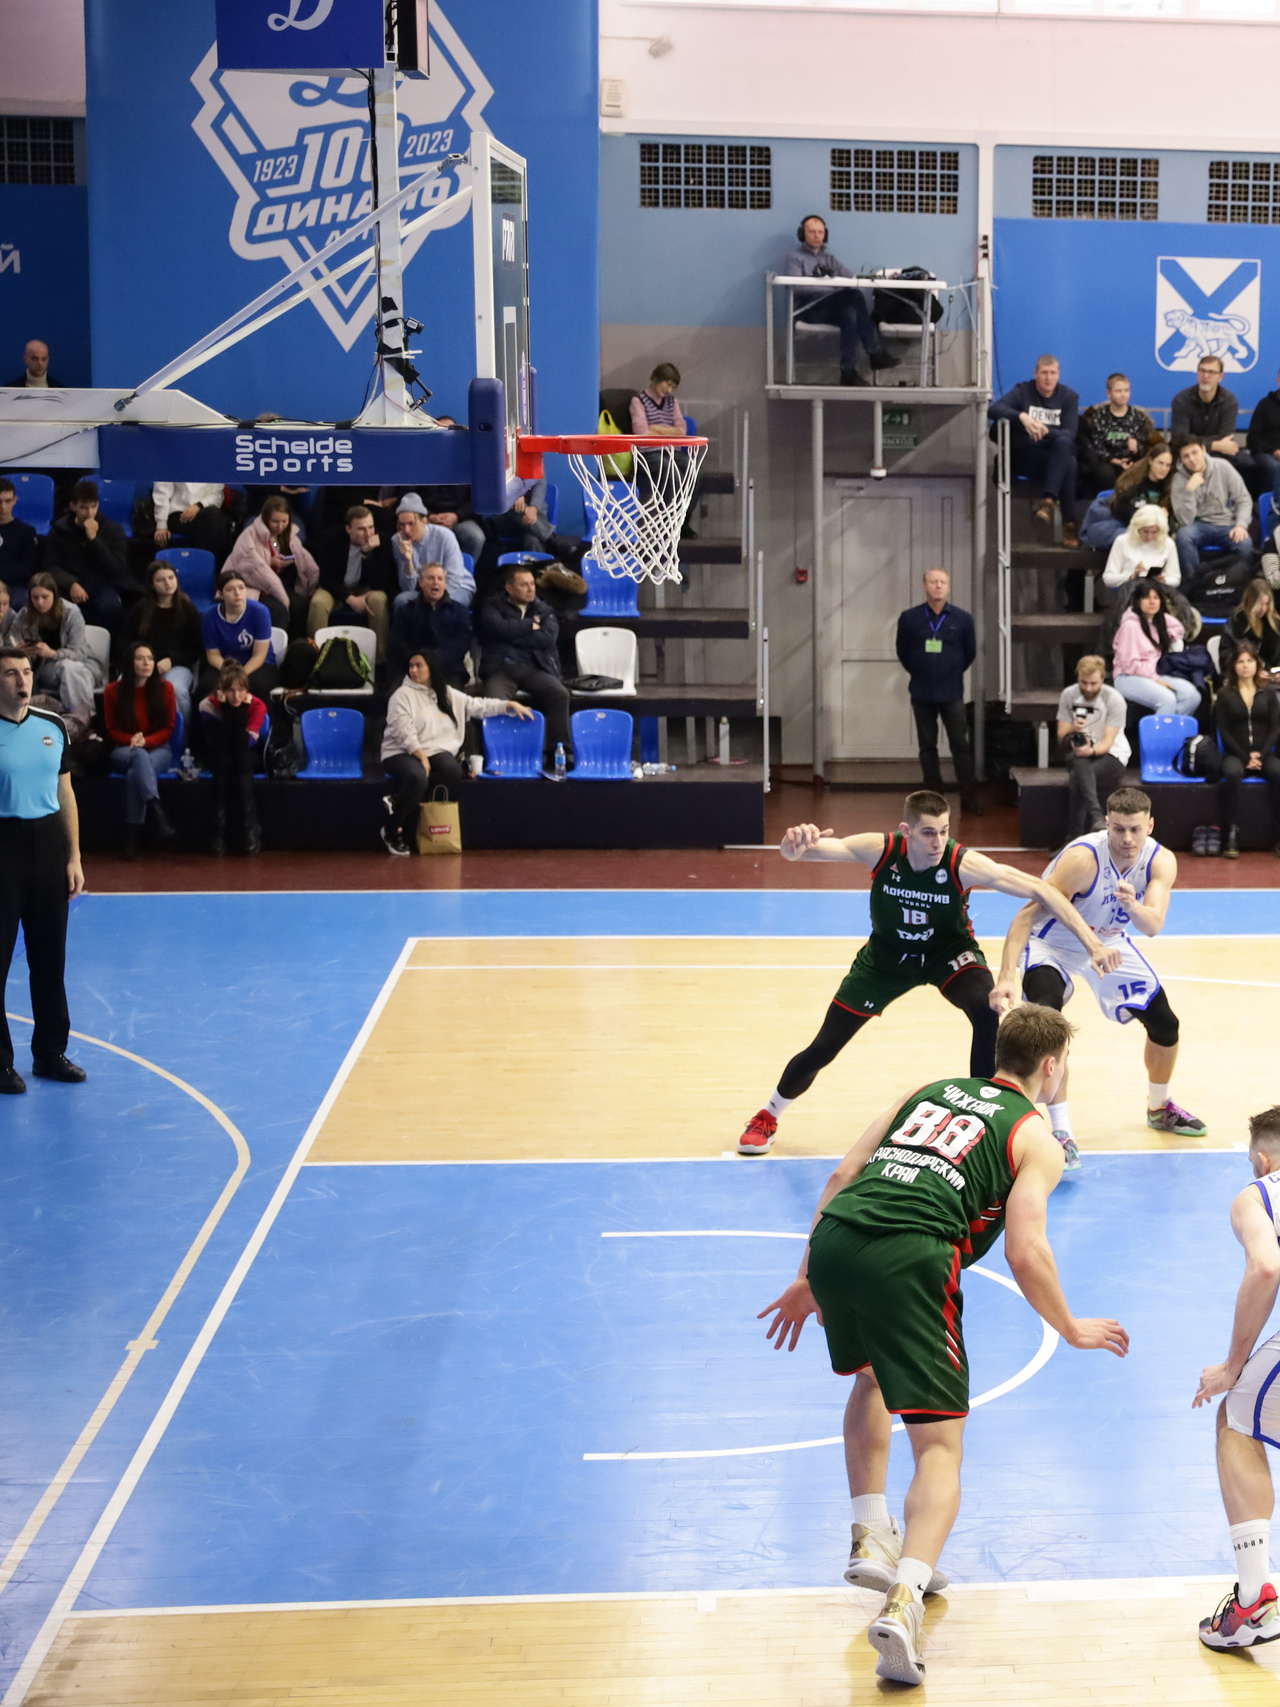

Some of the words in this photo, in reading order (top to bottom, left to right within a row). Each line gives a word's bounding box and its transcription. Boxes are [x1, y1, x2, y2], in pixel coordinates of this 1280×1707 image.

[252, 153, 299, 184] 1923
[403, 129, 454, 159] 2023
[235, 434, 353, 455] Schelde
[235, 453, 354, 477] Sports
[882, 884, 950, 904] ЛОКОМОТИВ
[901, 906, 929, 926] 18
[947, 950, 978, 972] 18
[1117, 980, 1147, 1001] 15
[890, 1100, 987, 1166] 88
[880, 1161, 921, 1184] КРАЙ
